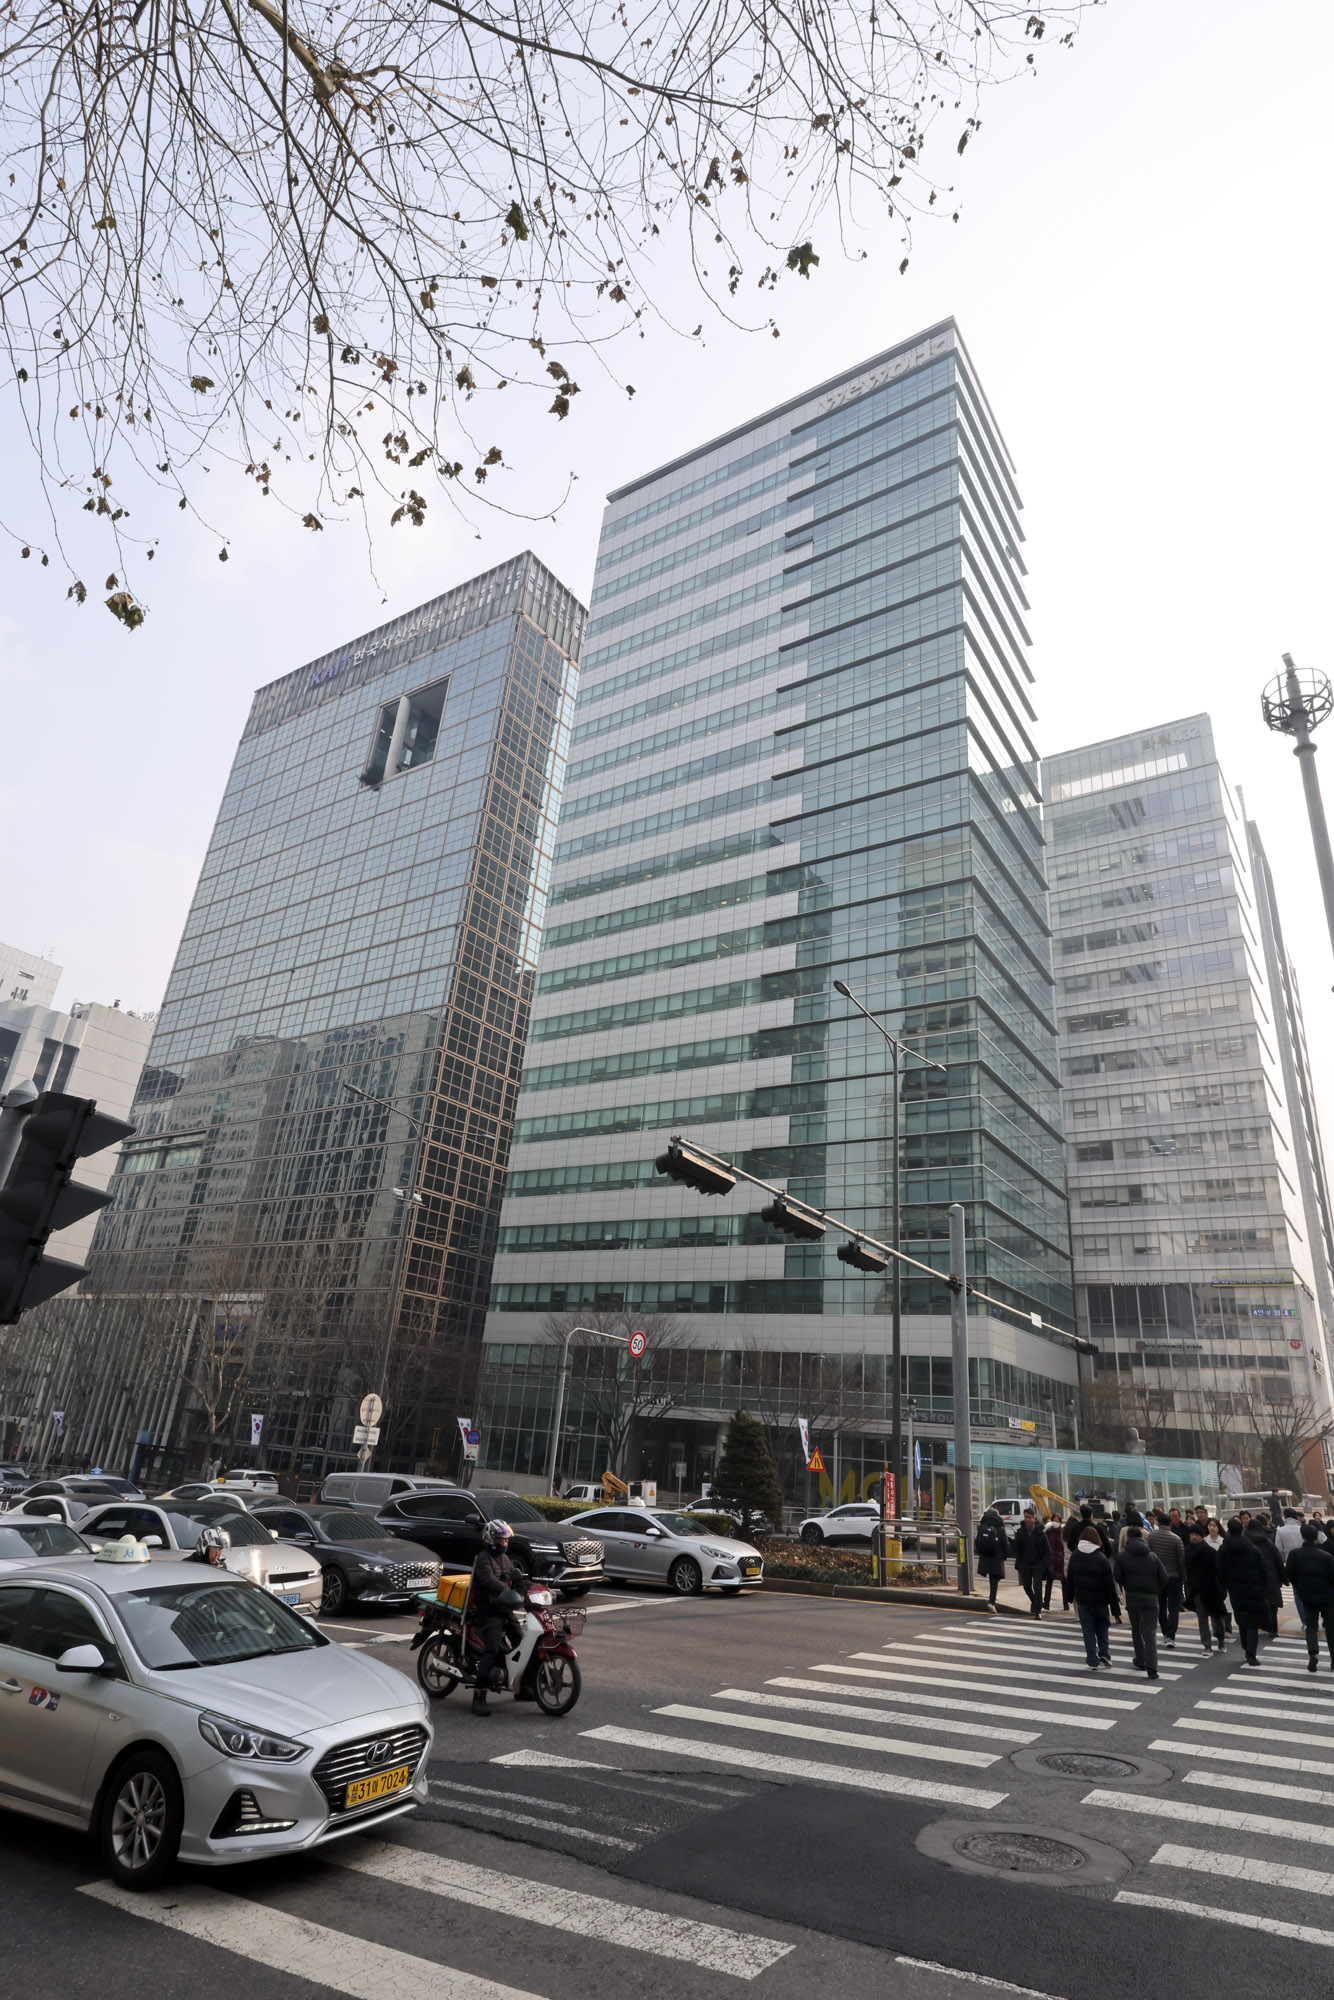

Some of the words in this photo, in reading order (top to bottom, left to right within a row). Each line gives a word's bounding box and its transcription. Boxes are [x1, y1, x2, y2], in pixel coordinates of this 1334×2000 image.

[820, 338, 946, 411] wework
[310, 655, 352, 689] KAIT
[353, 614, 434, 666] 한국자산신탁
[1141, 731, 1171, 751] 타워
[632, 1338, 643, 1351] 50
[931, 1413, 954, 1424] TOU
[972, 1415, 996, 1426] LAB
[381, 1769, 407, 1792] 7024
